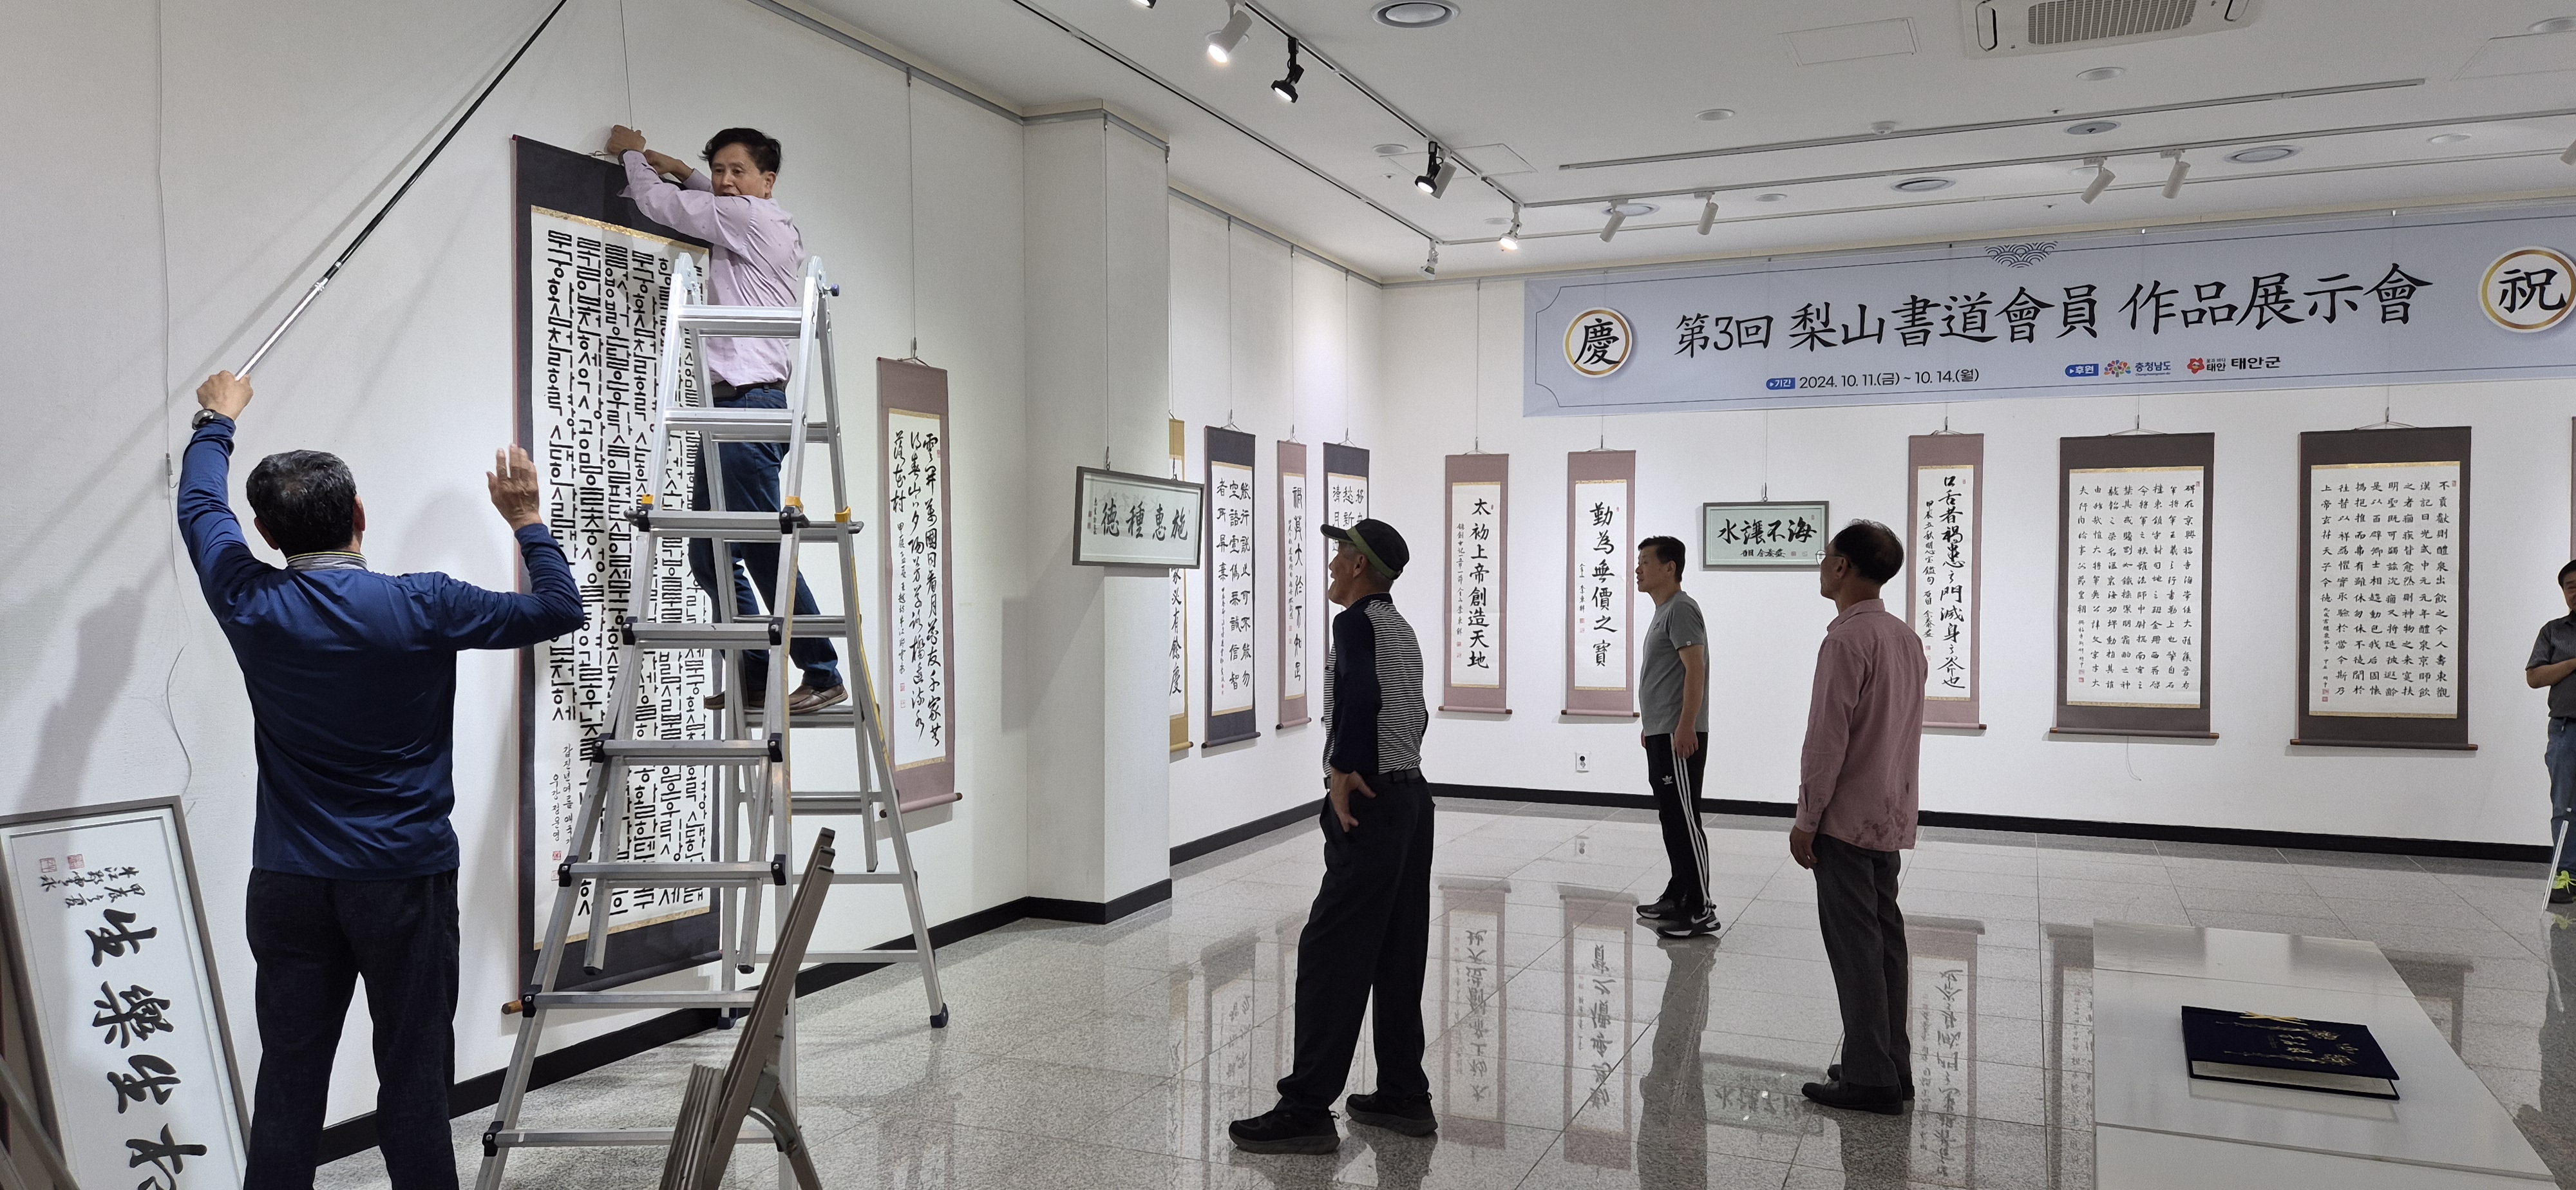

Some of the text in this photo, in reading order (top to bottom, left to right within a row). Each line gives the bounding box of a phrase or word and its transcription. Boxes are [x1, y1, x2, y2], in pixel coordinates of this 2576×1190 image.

[2497, 267, 2568, 314] 祝
[1674, 263, 2434, 359] 第3回 梨山書道會員 作品展示會
[1573, 317, 1622, 366] 慶
[2075, 365, 2094, 375] 후원
[2134, 361, 2171, 372] 충청남도
[2206, 363, 2226, 372] 태안
[2231, 356, 2281, 370] 태안군
[1774, 379, 1792, 388] 기간
[1799, 375, 1837, 389] 2024.
[1841, 374, 1859, 388] 10.
[1862, 372, 1900, 386] 11.(금)
[1915, 371, 1933, 384] 10.
[1937, 368, 1980, 383] 14.(월)
[1466, 498, 1492, 669] 太初上帝創造天地
